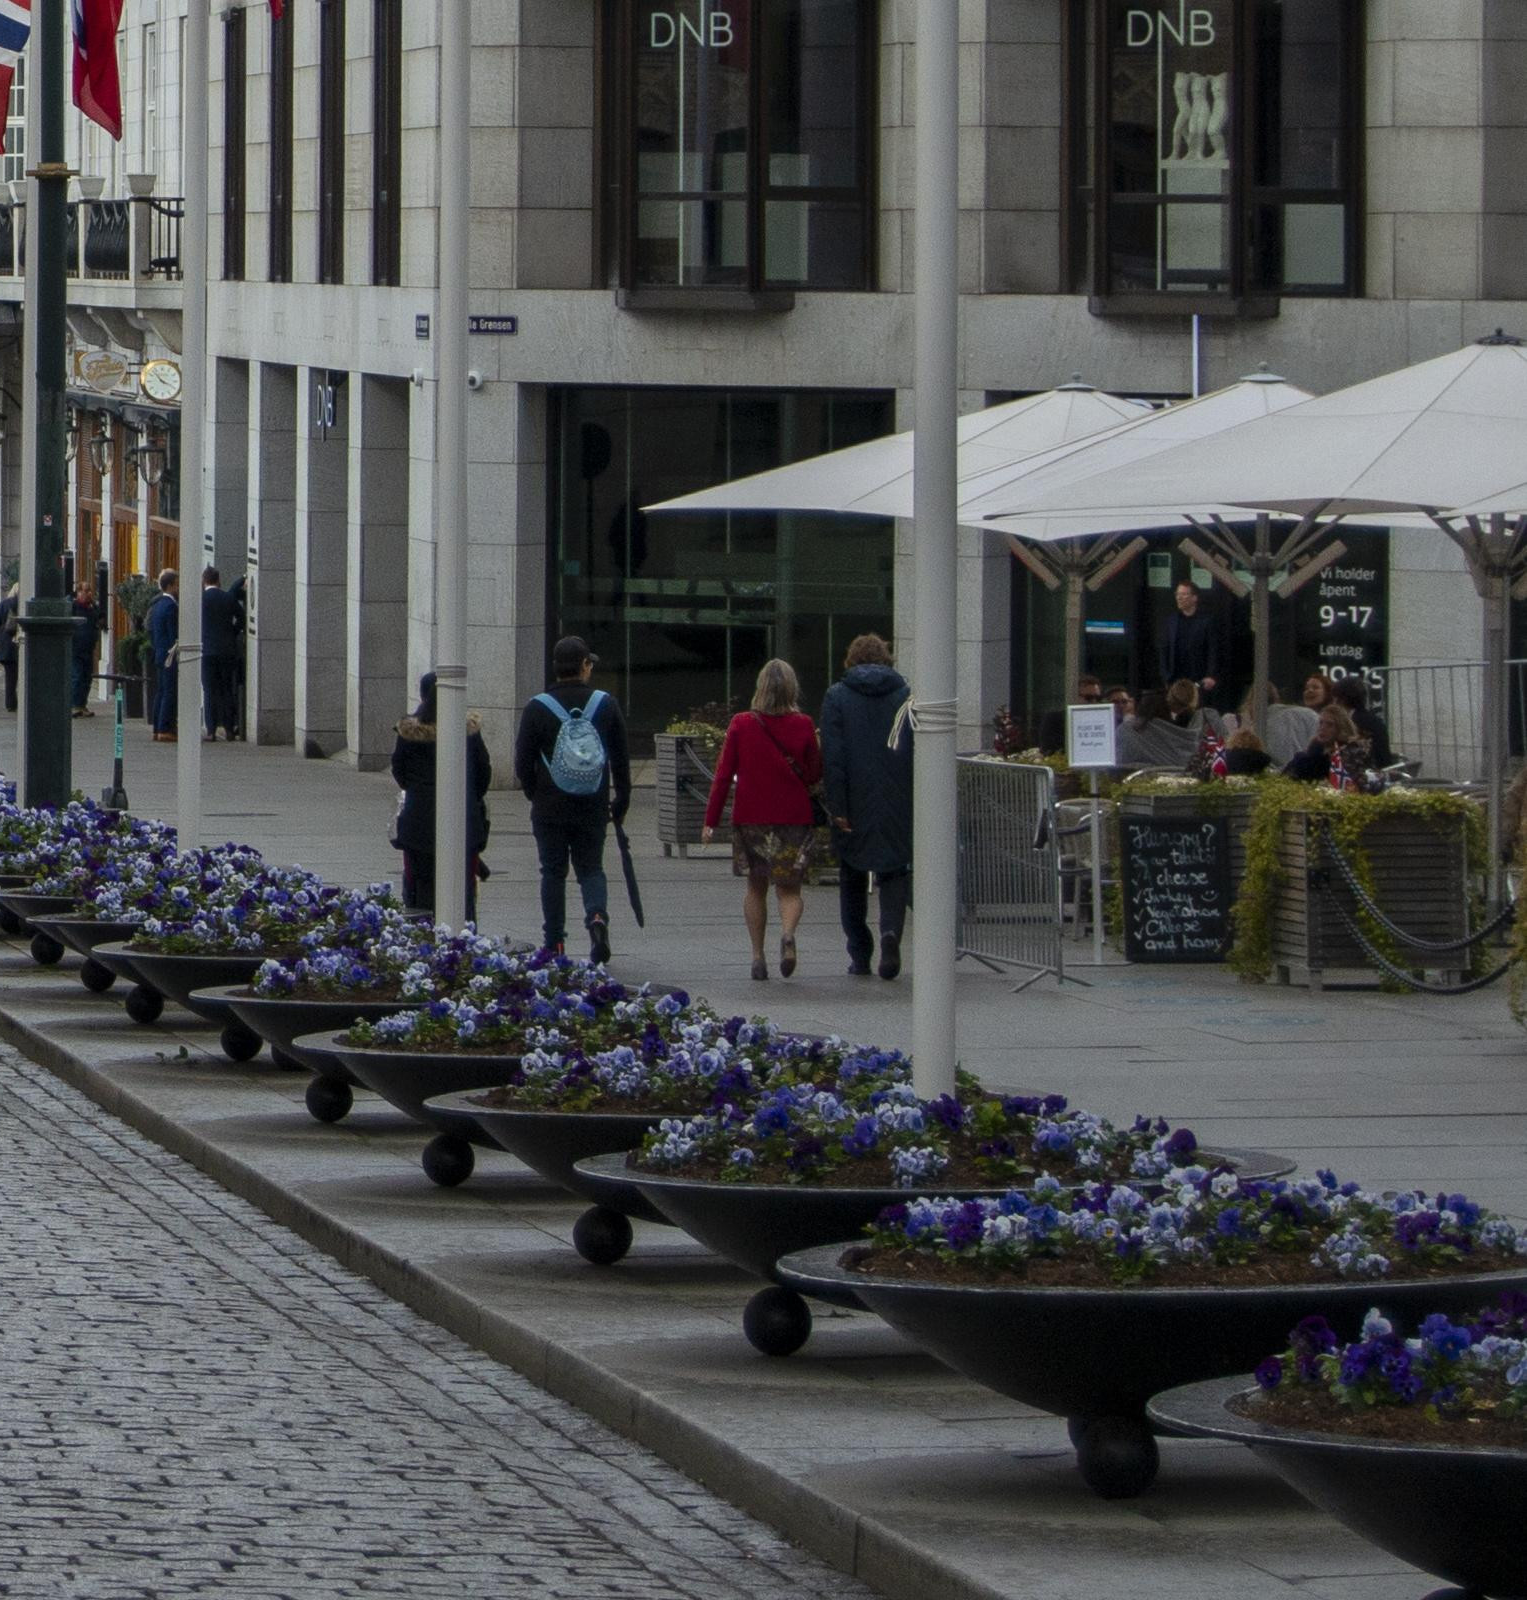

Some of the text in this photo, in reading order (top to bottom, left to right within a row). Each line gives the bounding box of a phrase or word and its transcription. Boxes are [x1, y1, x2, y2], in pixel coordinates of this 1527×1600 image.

[650, 12, 733, 47] DNB
[1127, 9, 1215, 46] DNB
[479, 318, 513, 331] Grensen
[316, 384, 333, 428] DNB
[1320, 566, 1376, 581] Vi holder
[1319, 584, 1357, 598] åpent
[1319, 605, 1373, 628] 9-17
[1319, 644, 1364, 660] Lørdag
[1128, 823, 1217, 848] Hungry?
[1143, 887, 1194, 911] Turkey
[1145, 919, 1203, 937] Cheese
[1144, 935, 1177, 950] and
